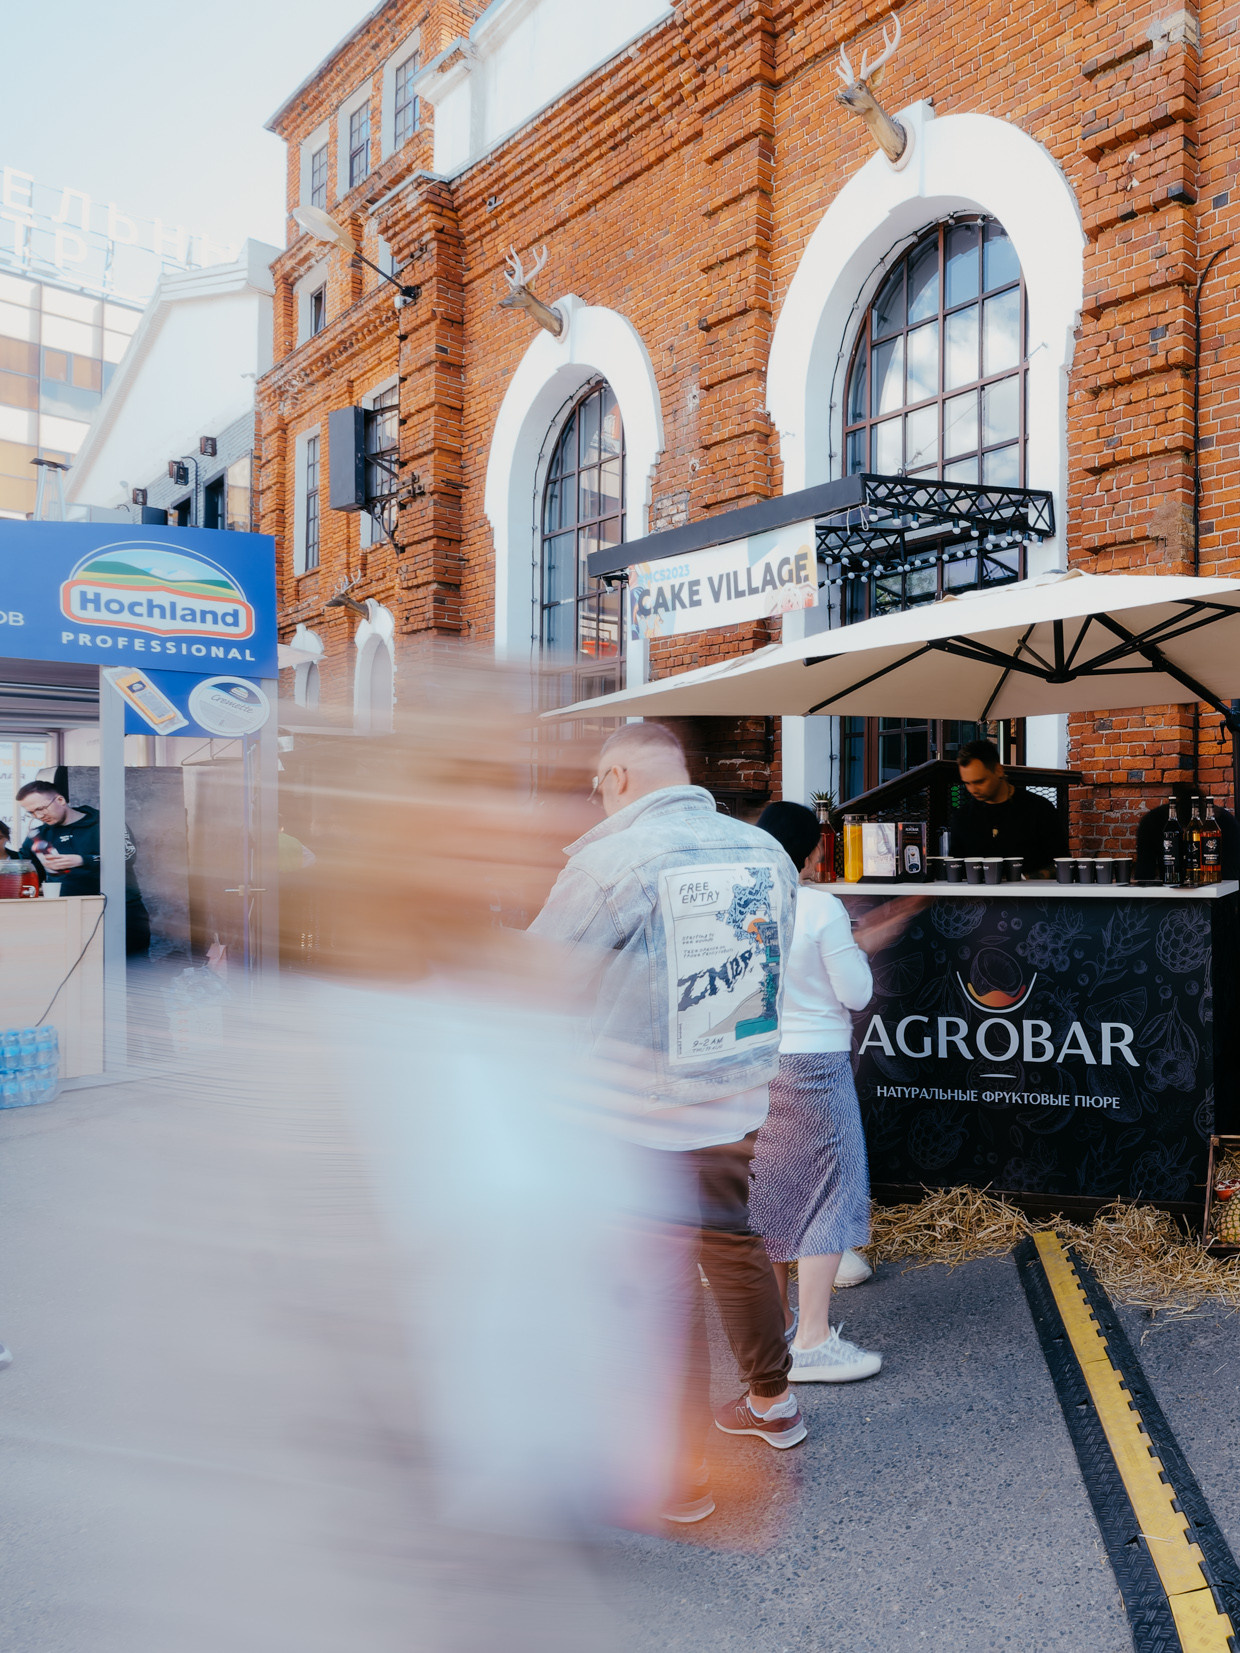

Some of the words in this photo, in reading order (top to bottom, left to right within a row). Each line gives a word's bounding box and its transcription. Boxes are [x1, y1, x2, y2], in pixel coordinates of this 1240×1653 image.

[637, 578, 702, 616] CAKE
[707, 552, 809, 604] VILLAGE
[79, 590, 240, 628] Hochland
[61, 631, 256, 662] PROFESSIONAL
[679, 881, 710, 895] FREE
[682, 890, 719, 904] ENTRY
[857, 1014, 1140, 1067] AGROBAR
[876, 1085, 978, 1102] НАТУРАЛЬНЫЕ
[981, 1090, 1070, 1107] ФРУКТОВЫЕ
[1074, 1095, 1121, 1109] ПЮРЕ
